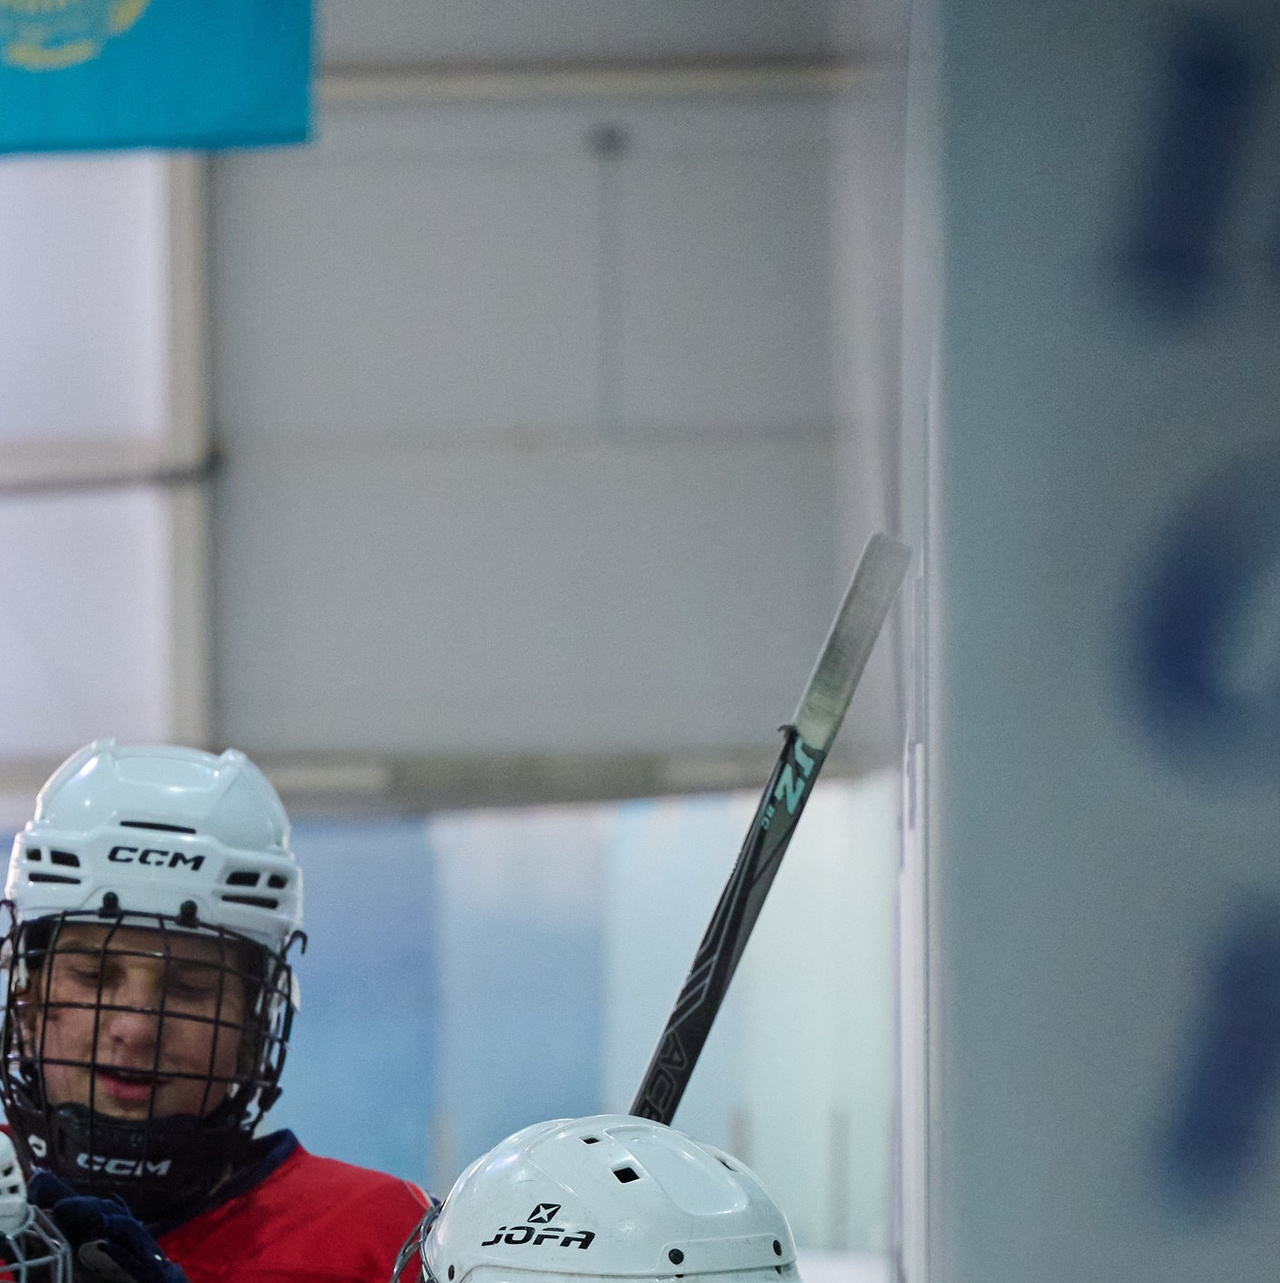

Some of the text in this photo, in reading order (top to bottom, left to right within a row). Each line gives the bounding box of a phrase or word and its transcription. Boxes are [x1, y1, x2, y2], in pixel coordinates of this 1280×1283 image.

[107, 845, 205, 872] CCM
[77, 1153, 172, 1178] CCM
[481, 1226, 595, 1250] JOFA
